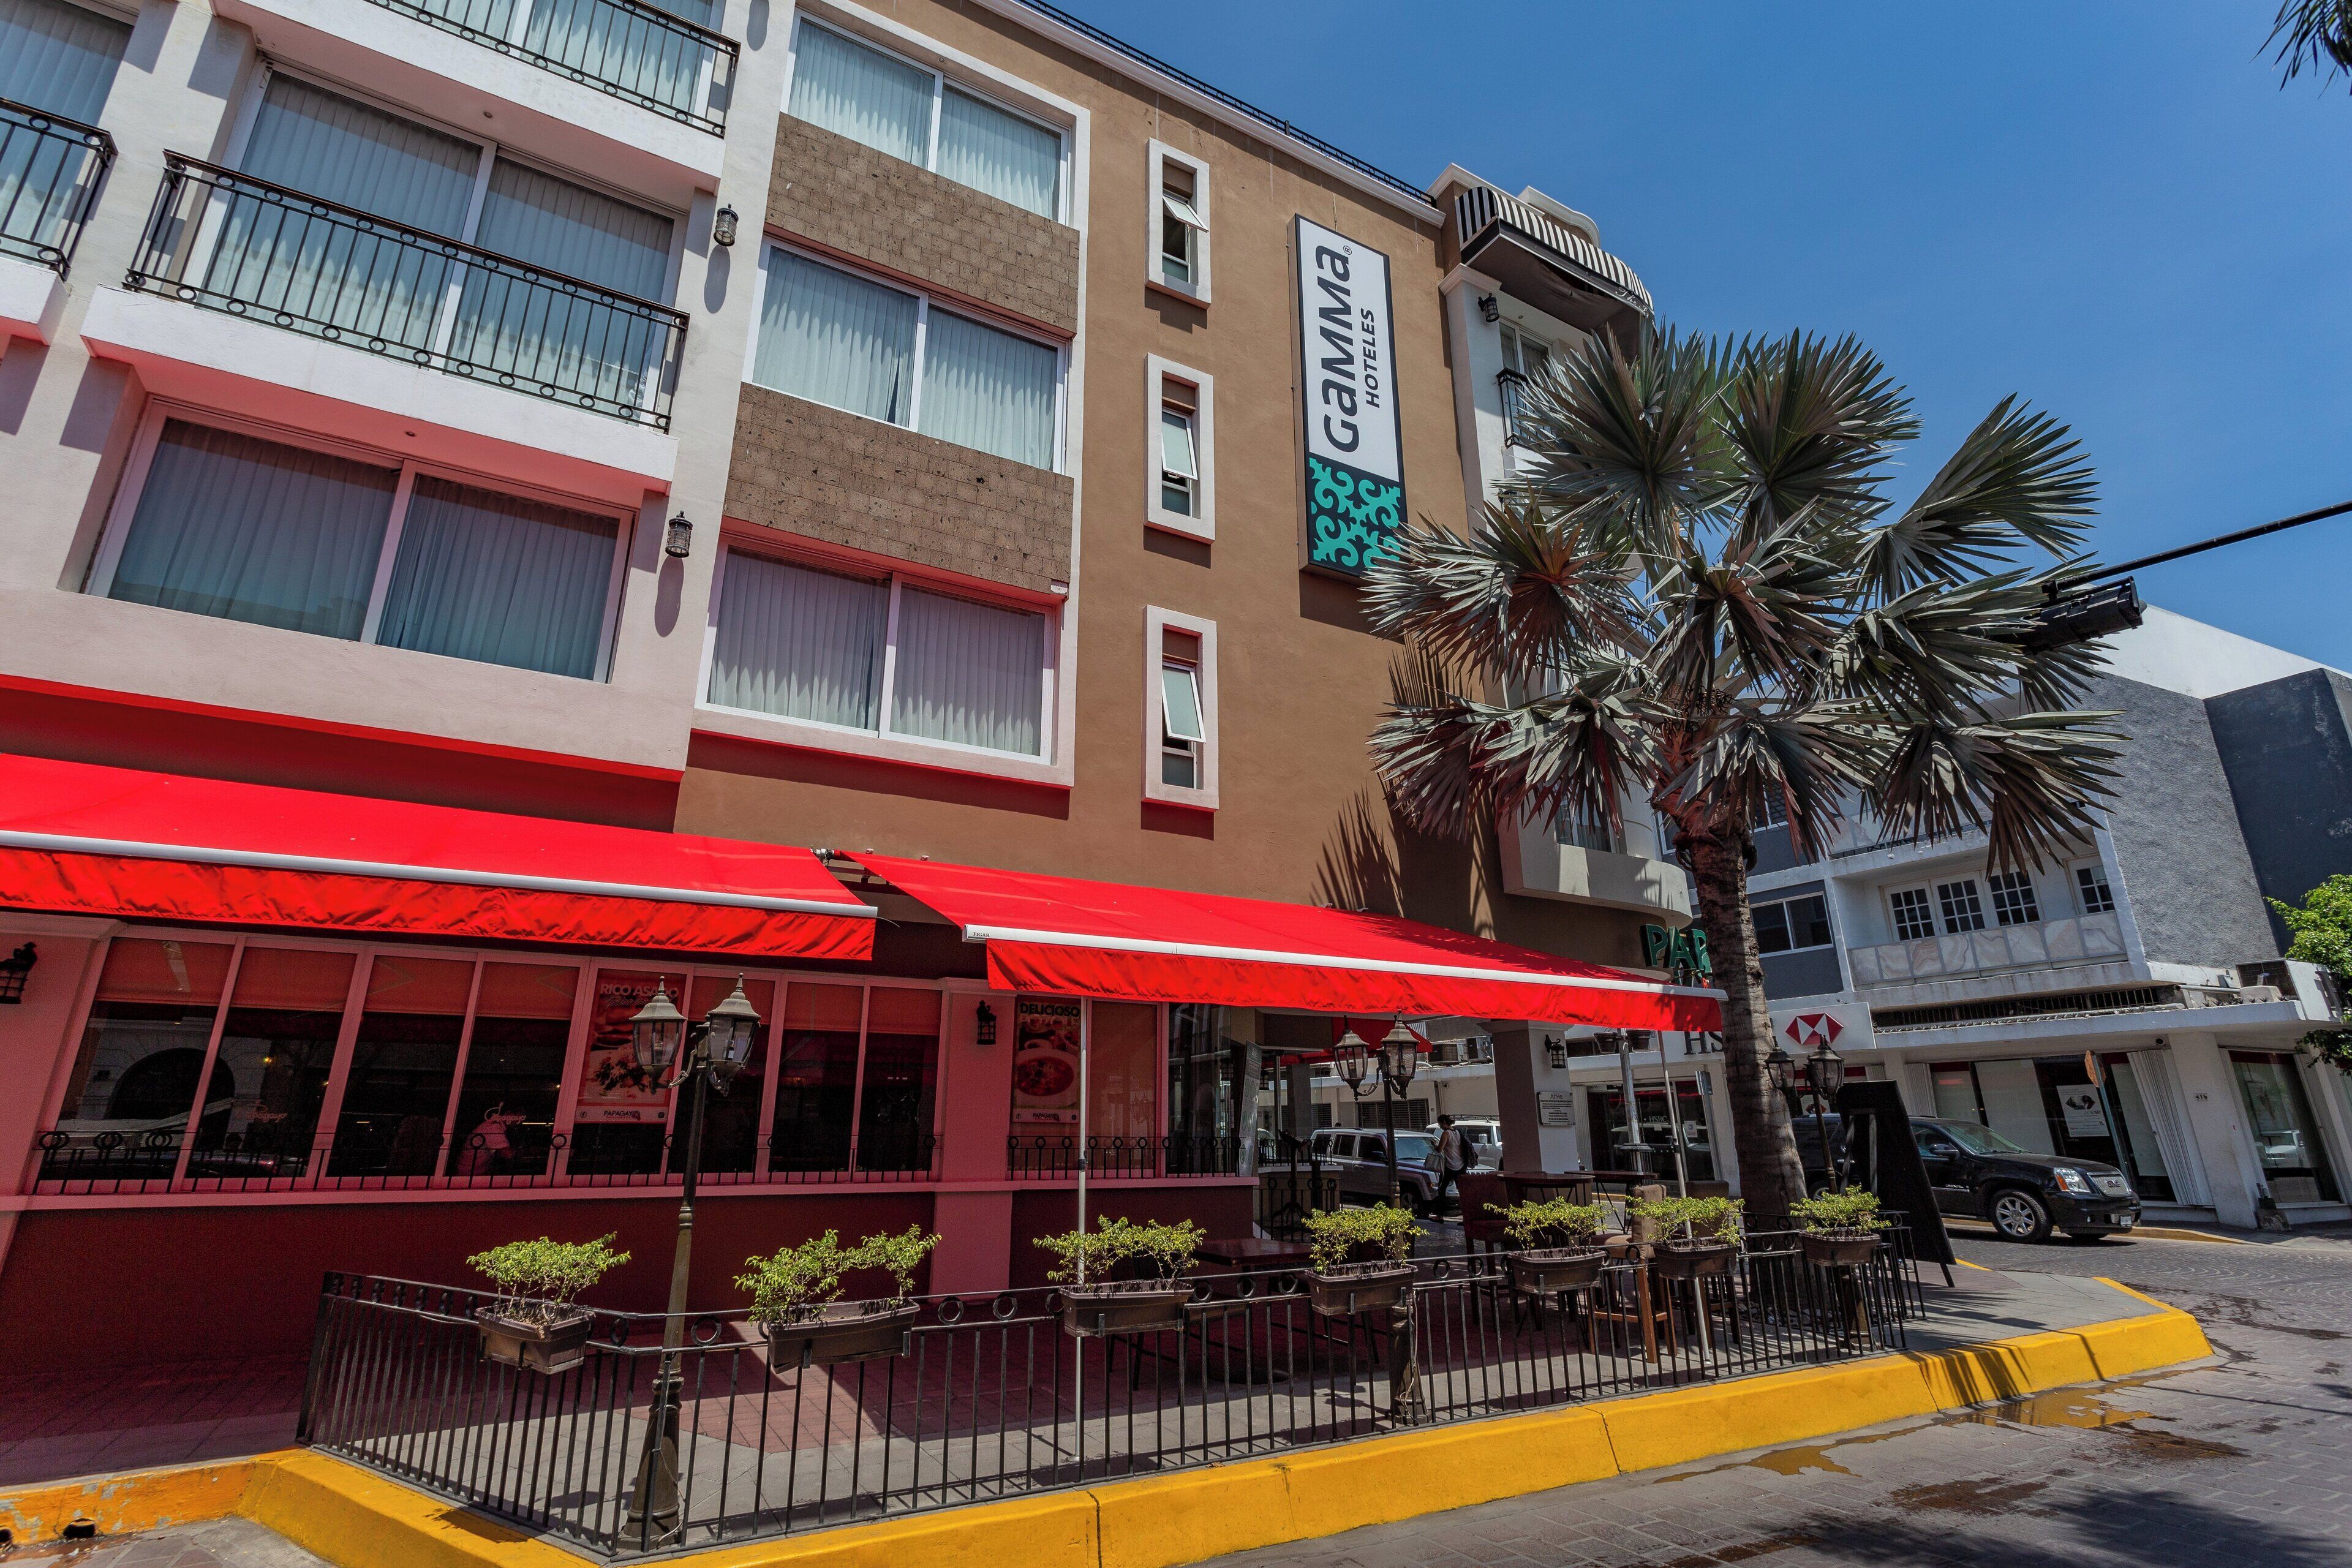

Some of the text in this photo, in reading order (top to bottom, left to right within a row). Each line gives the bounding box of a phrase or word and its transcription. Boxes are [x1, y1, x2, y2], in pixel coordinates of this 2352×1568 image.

[1360, 307, 1380, 409] HOTELES
[600, 984, 632, 996] RICO
[1020, 1003, 1080, 1017] DELICIOSO
